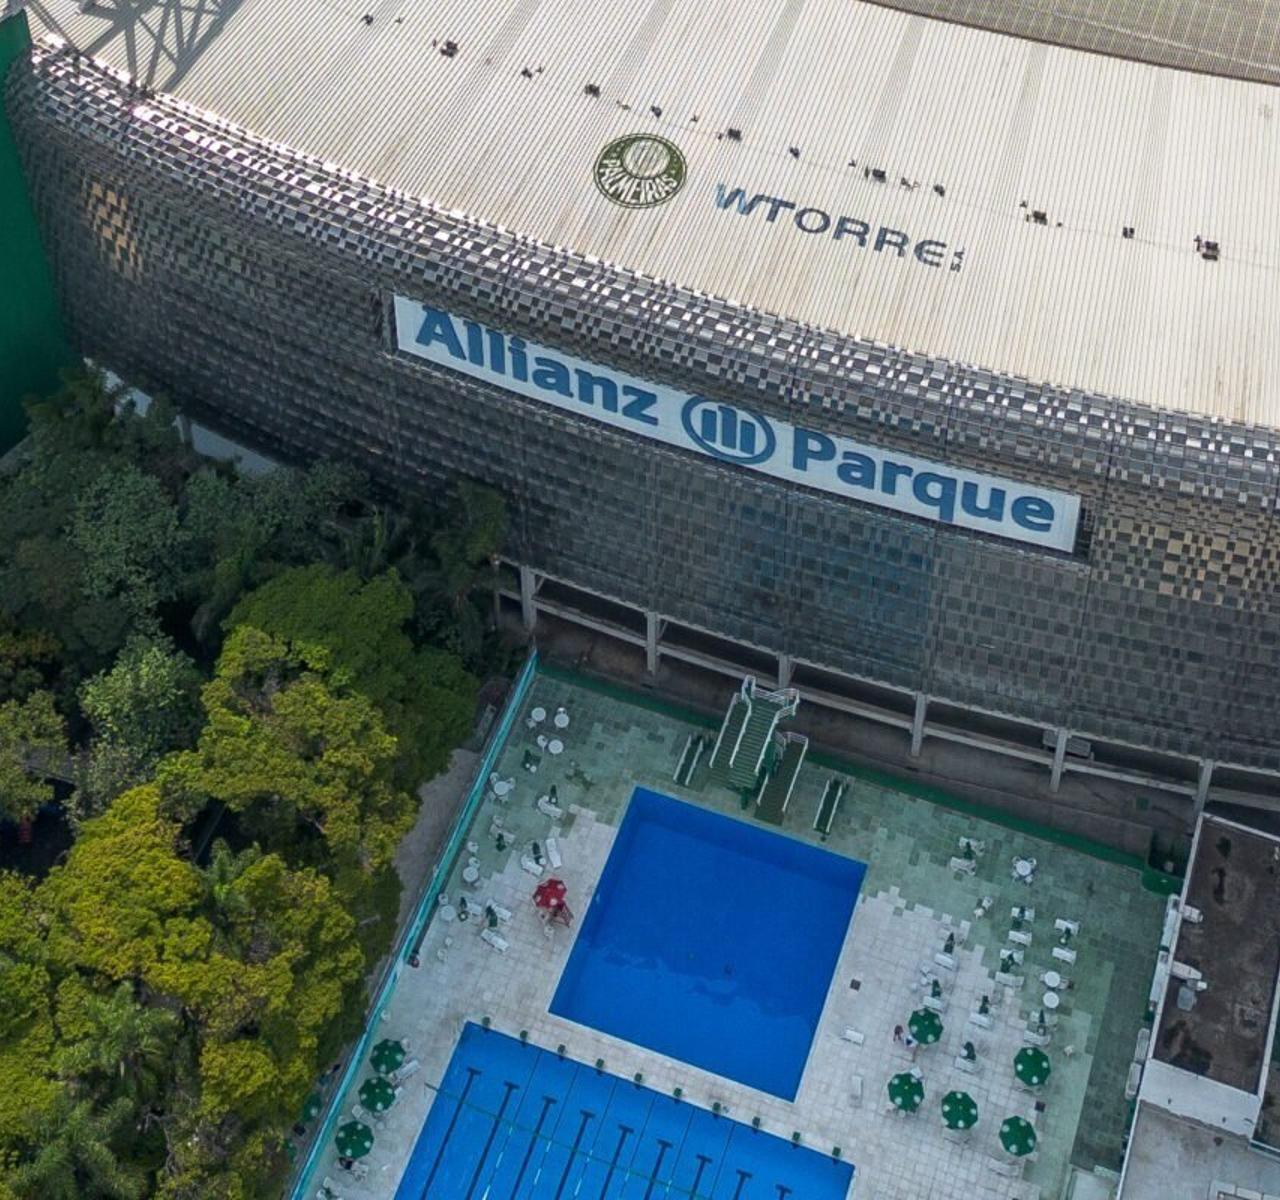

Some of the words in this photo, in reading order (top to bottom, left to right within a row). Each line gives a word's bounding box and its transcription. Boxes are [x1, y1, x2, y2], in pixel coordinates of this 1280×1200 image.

[599, 158, 679, 204] PALMEIRAS
[713, 182, 948, 268] WTORRE
[415, 303, 659, 427] Allianz
[792, 426, 1055, 533] Parque
